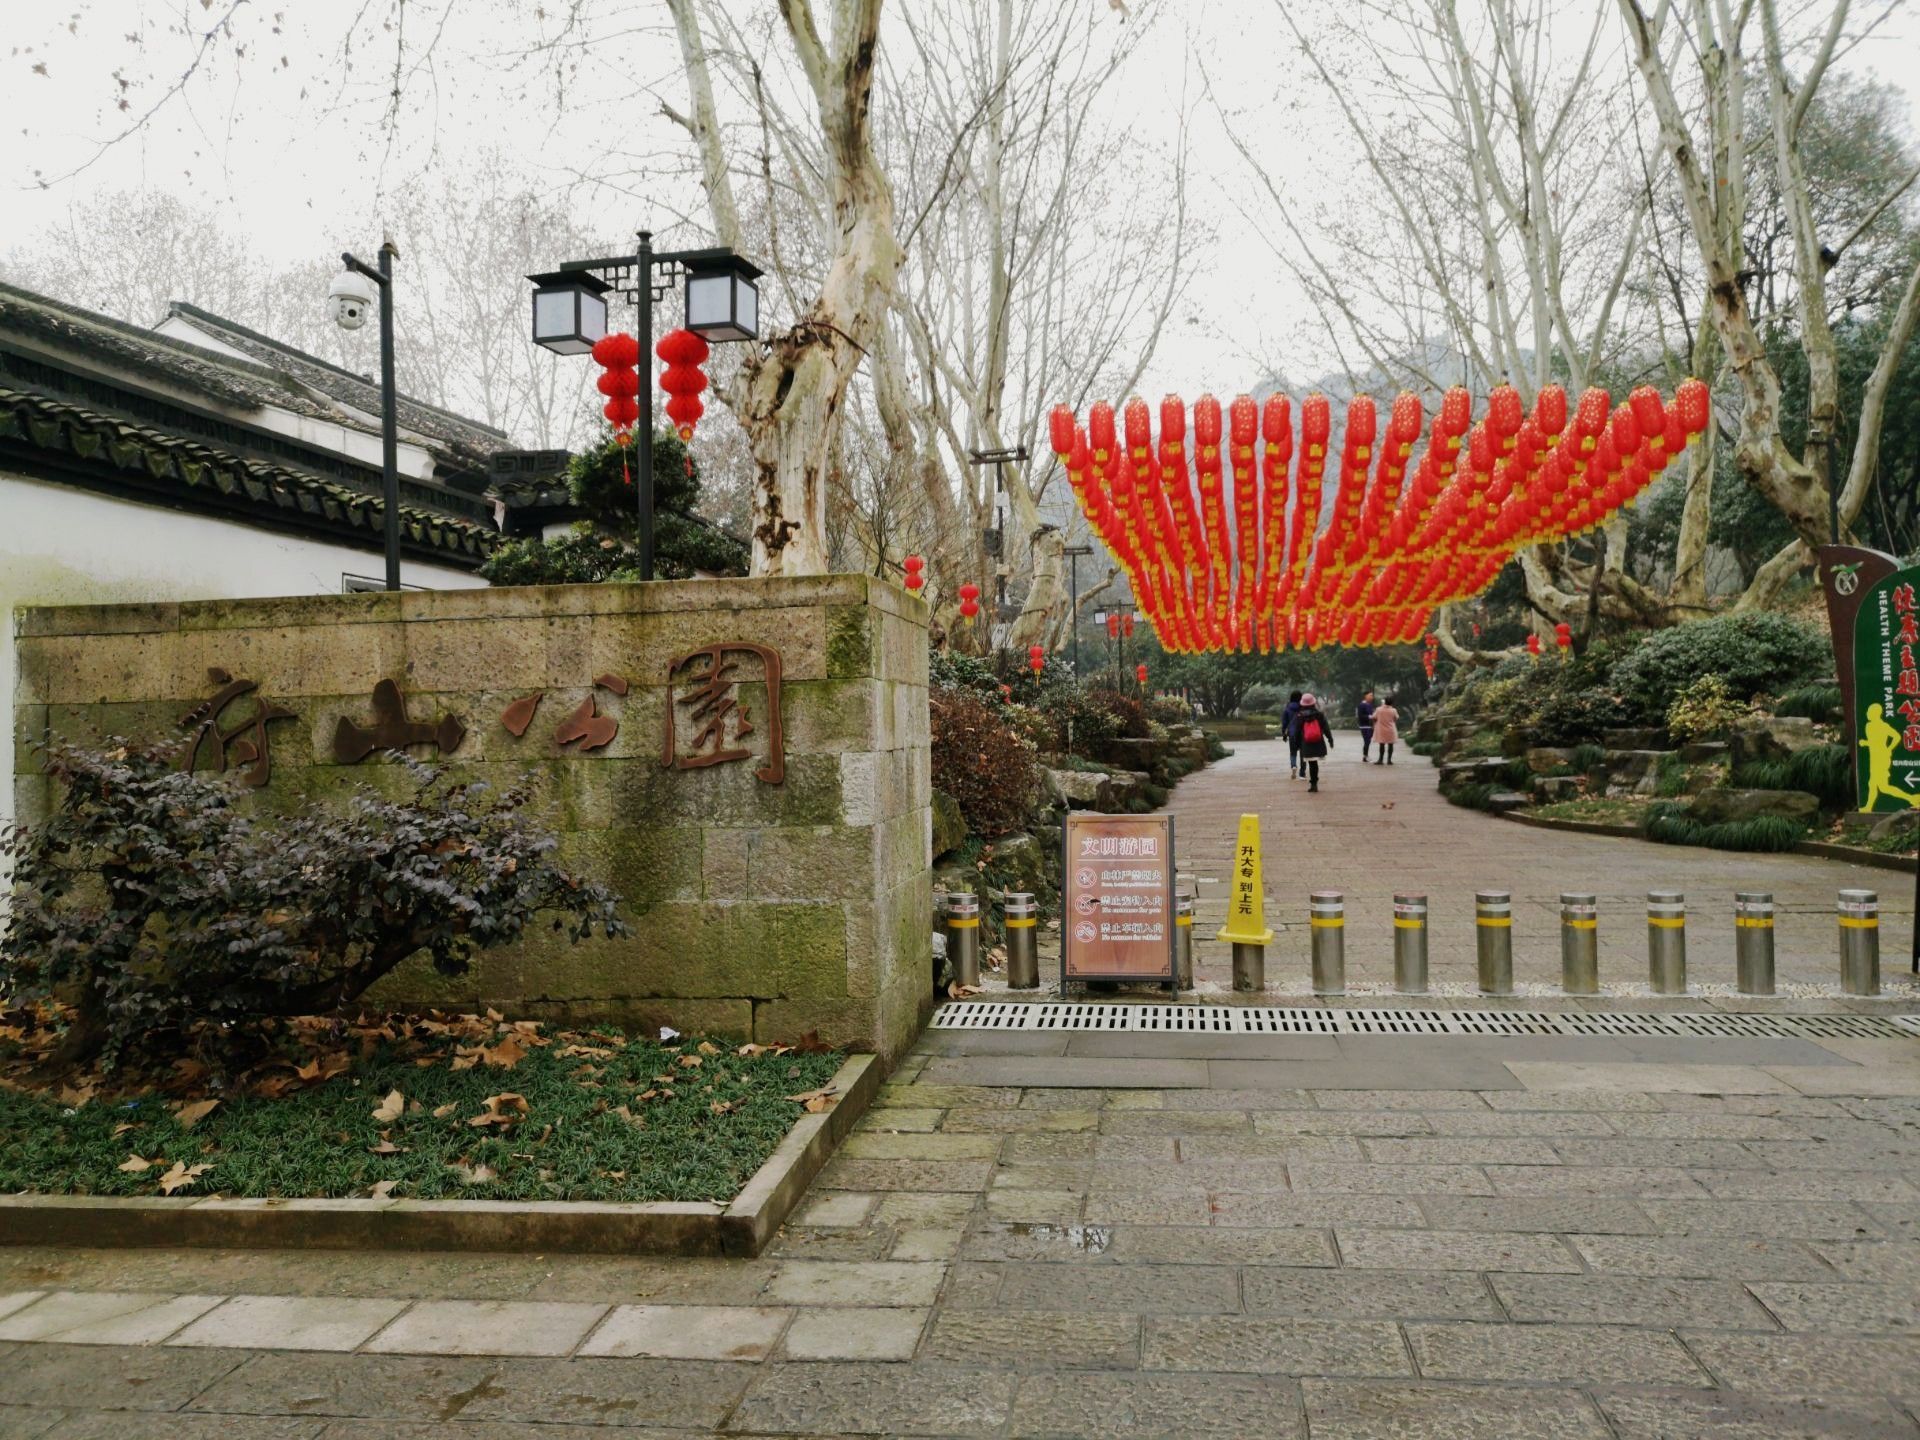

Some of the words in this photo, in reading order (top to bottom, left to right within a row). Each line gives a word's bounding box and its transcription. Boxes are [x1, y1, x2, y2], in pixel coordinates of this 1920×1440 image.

[1878, 590, 1890, 636] HEALTH
[1882, 641, 1892, 682] THEME
[1884, 686, 1895, 718] PARK
[1080, 837, 1158, 856] 文明游园
